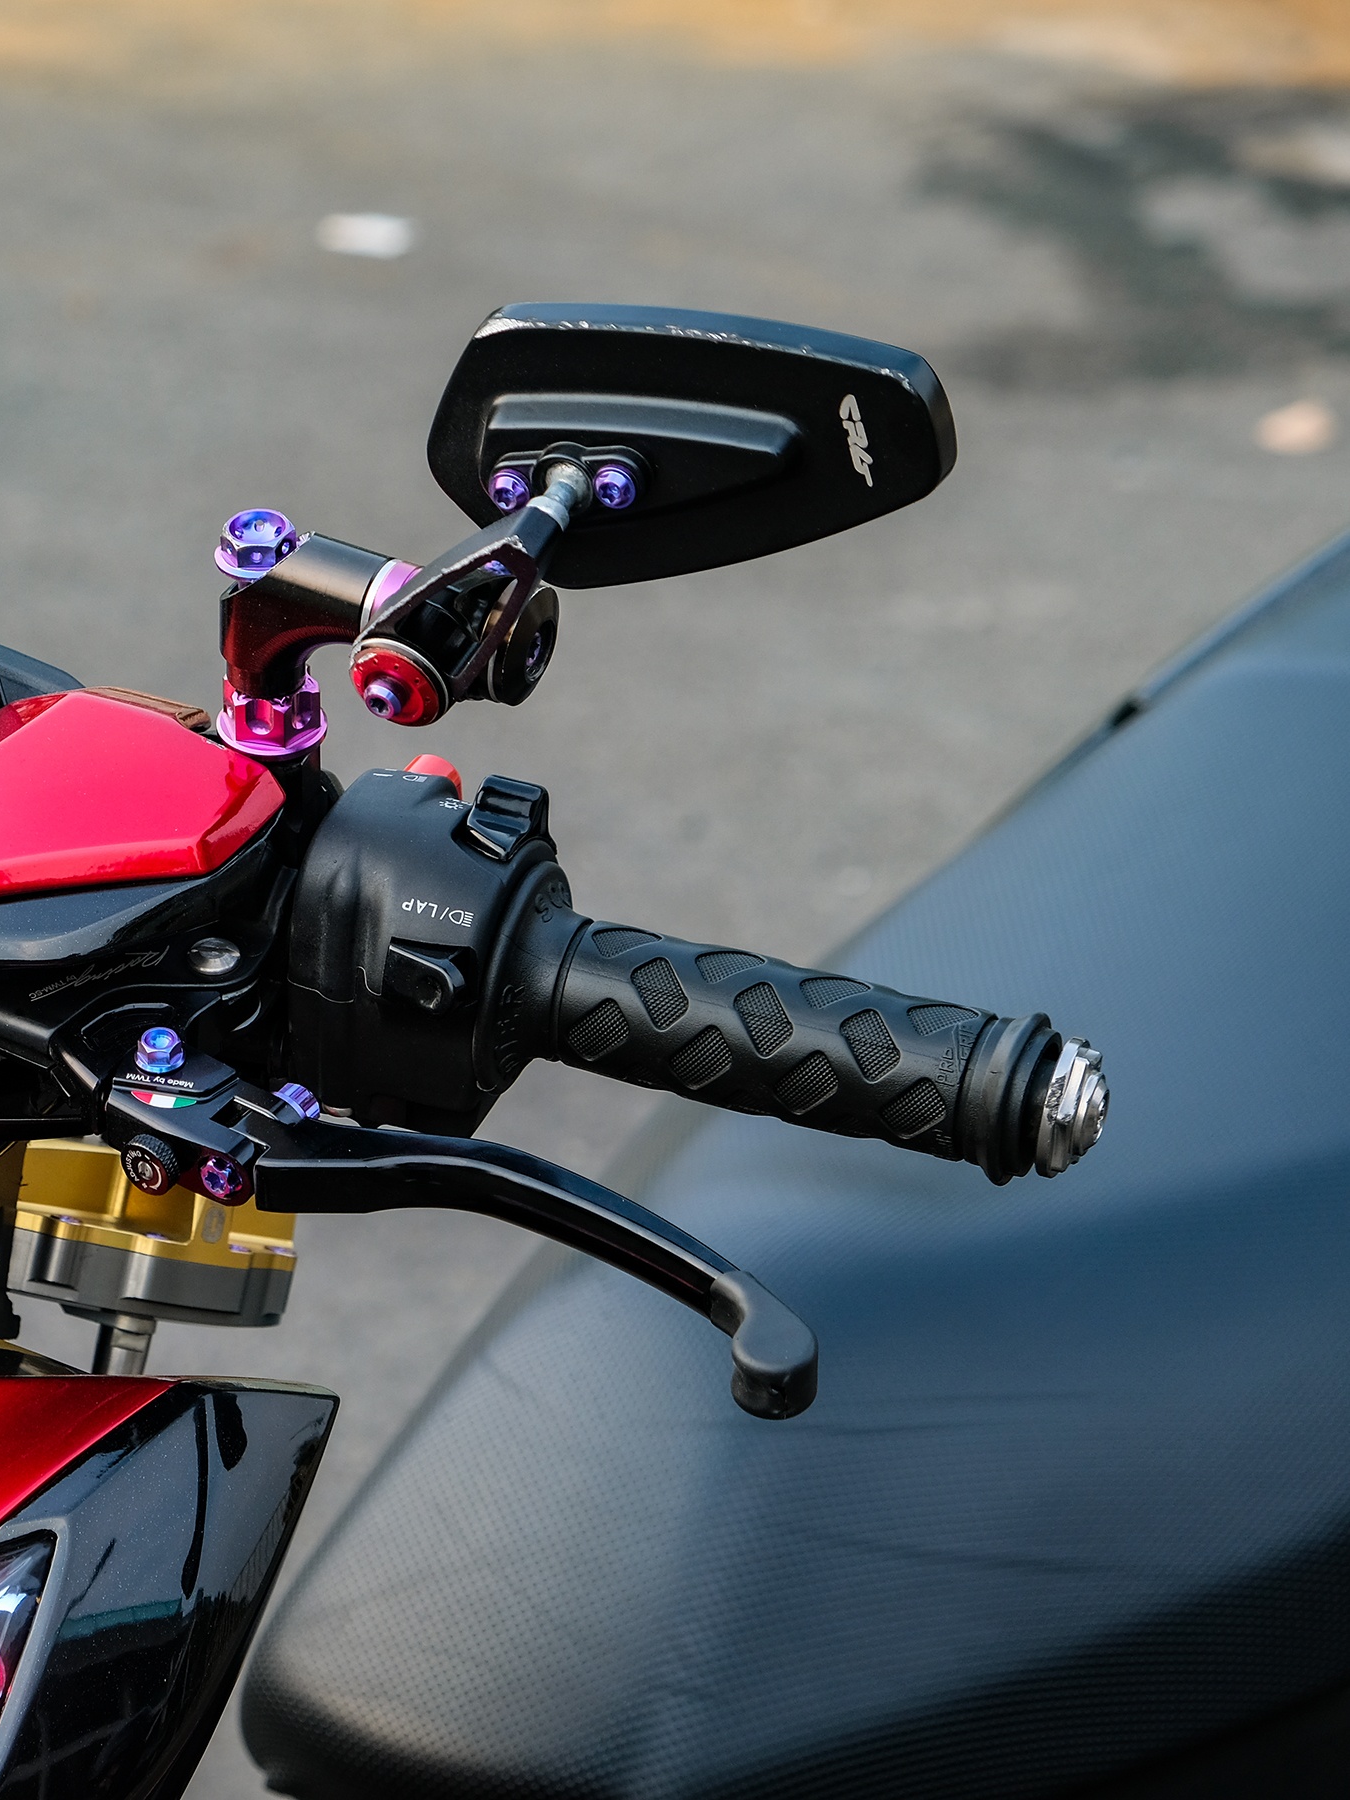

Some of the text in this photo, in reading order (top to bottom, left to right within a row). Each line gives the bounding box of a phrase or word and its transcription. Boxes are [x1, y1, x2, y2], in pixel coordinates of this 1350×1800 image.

[125, 1073, 195, 1089] Made by TWM
